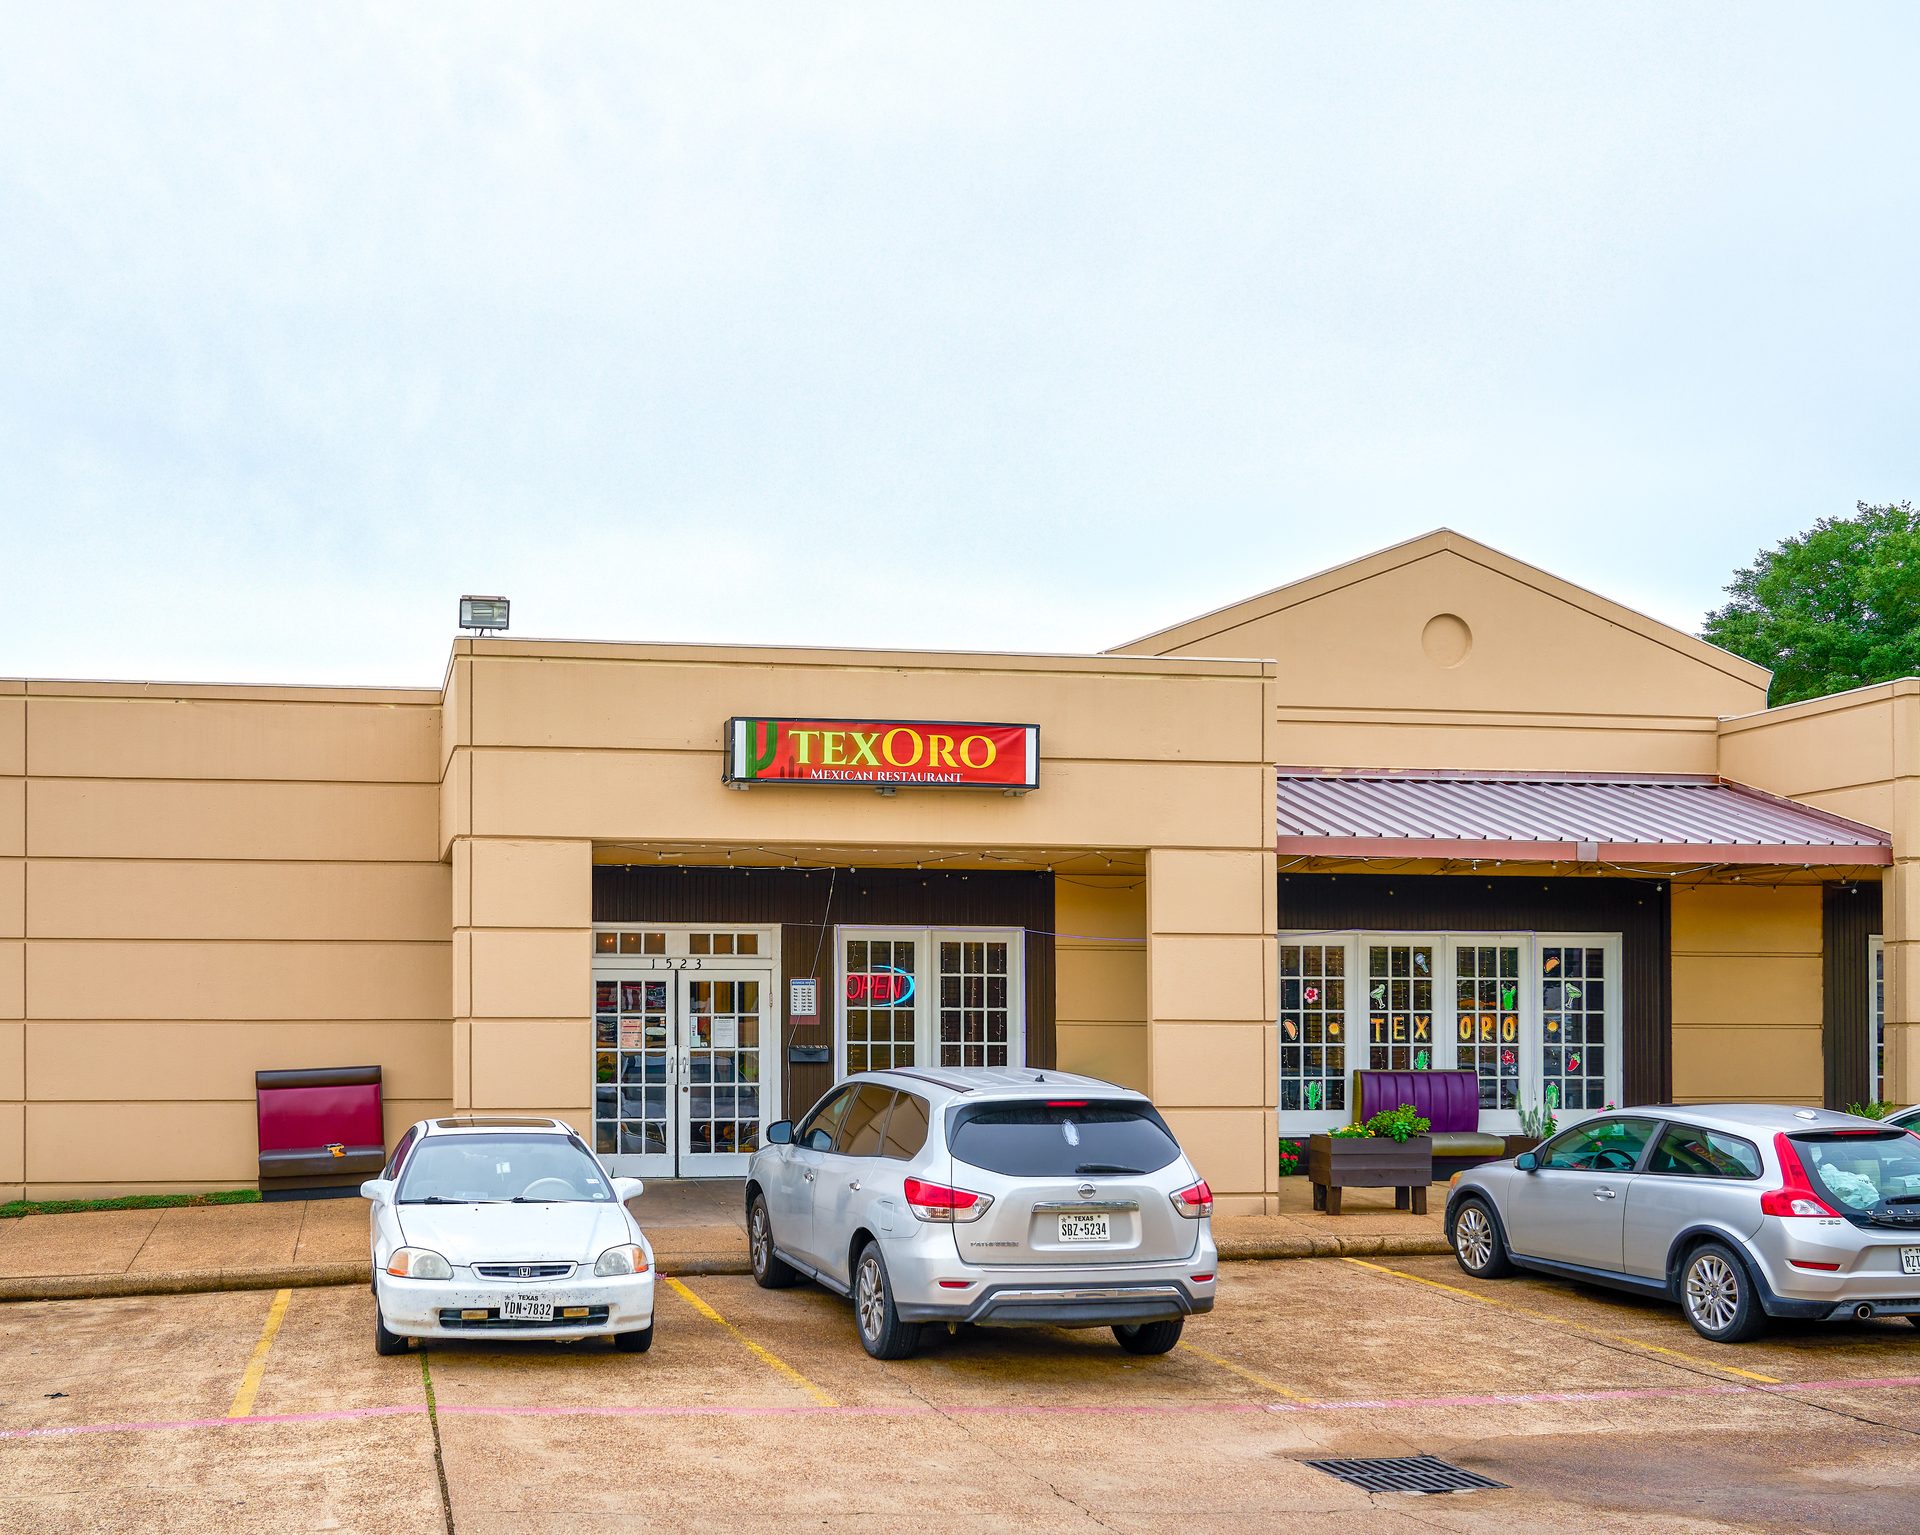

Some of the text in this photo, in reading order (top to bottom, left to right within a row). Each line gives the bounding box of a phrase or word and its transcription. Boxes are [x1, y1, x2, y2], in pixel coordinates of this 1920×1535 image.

[810, 768, 963, 783] MEXICAN RESTAURANT
[651, 958, 702, 970] 1523
[846, 973, 902, 999] OPEN
[1370, 1015, 1516, 1042] TEX ORO
